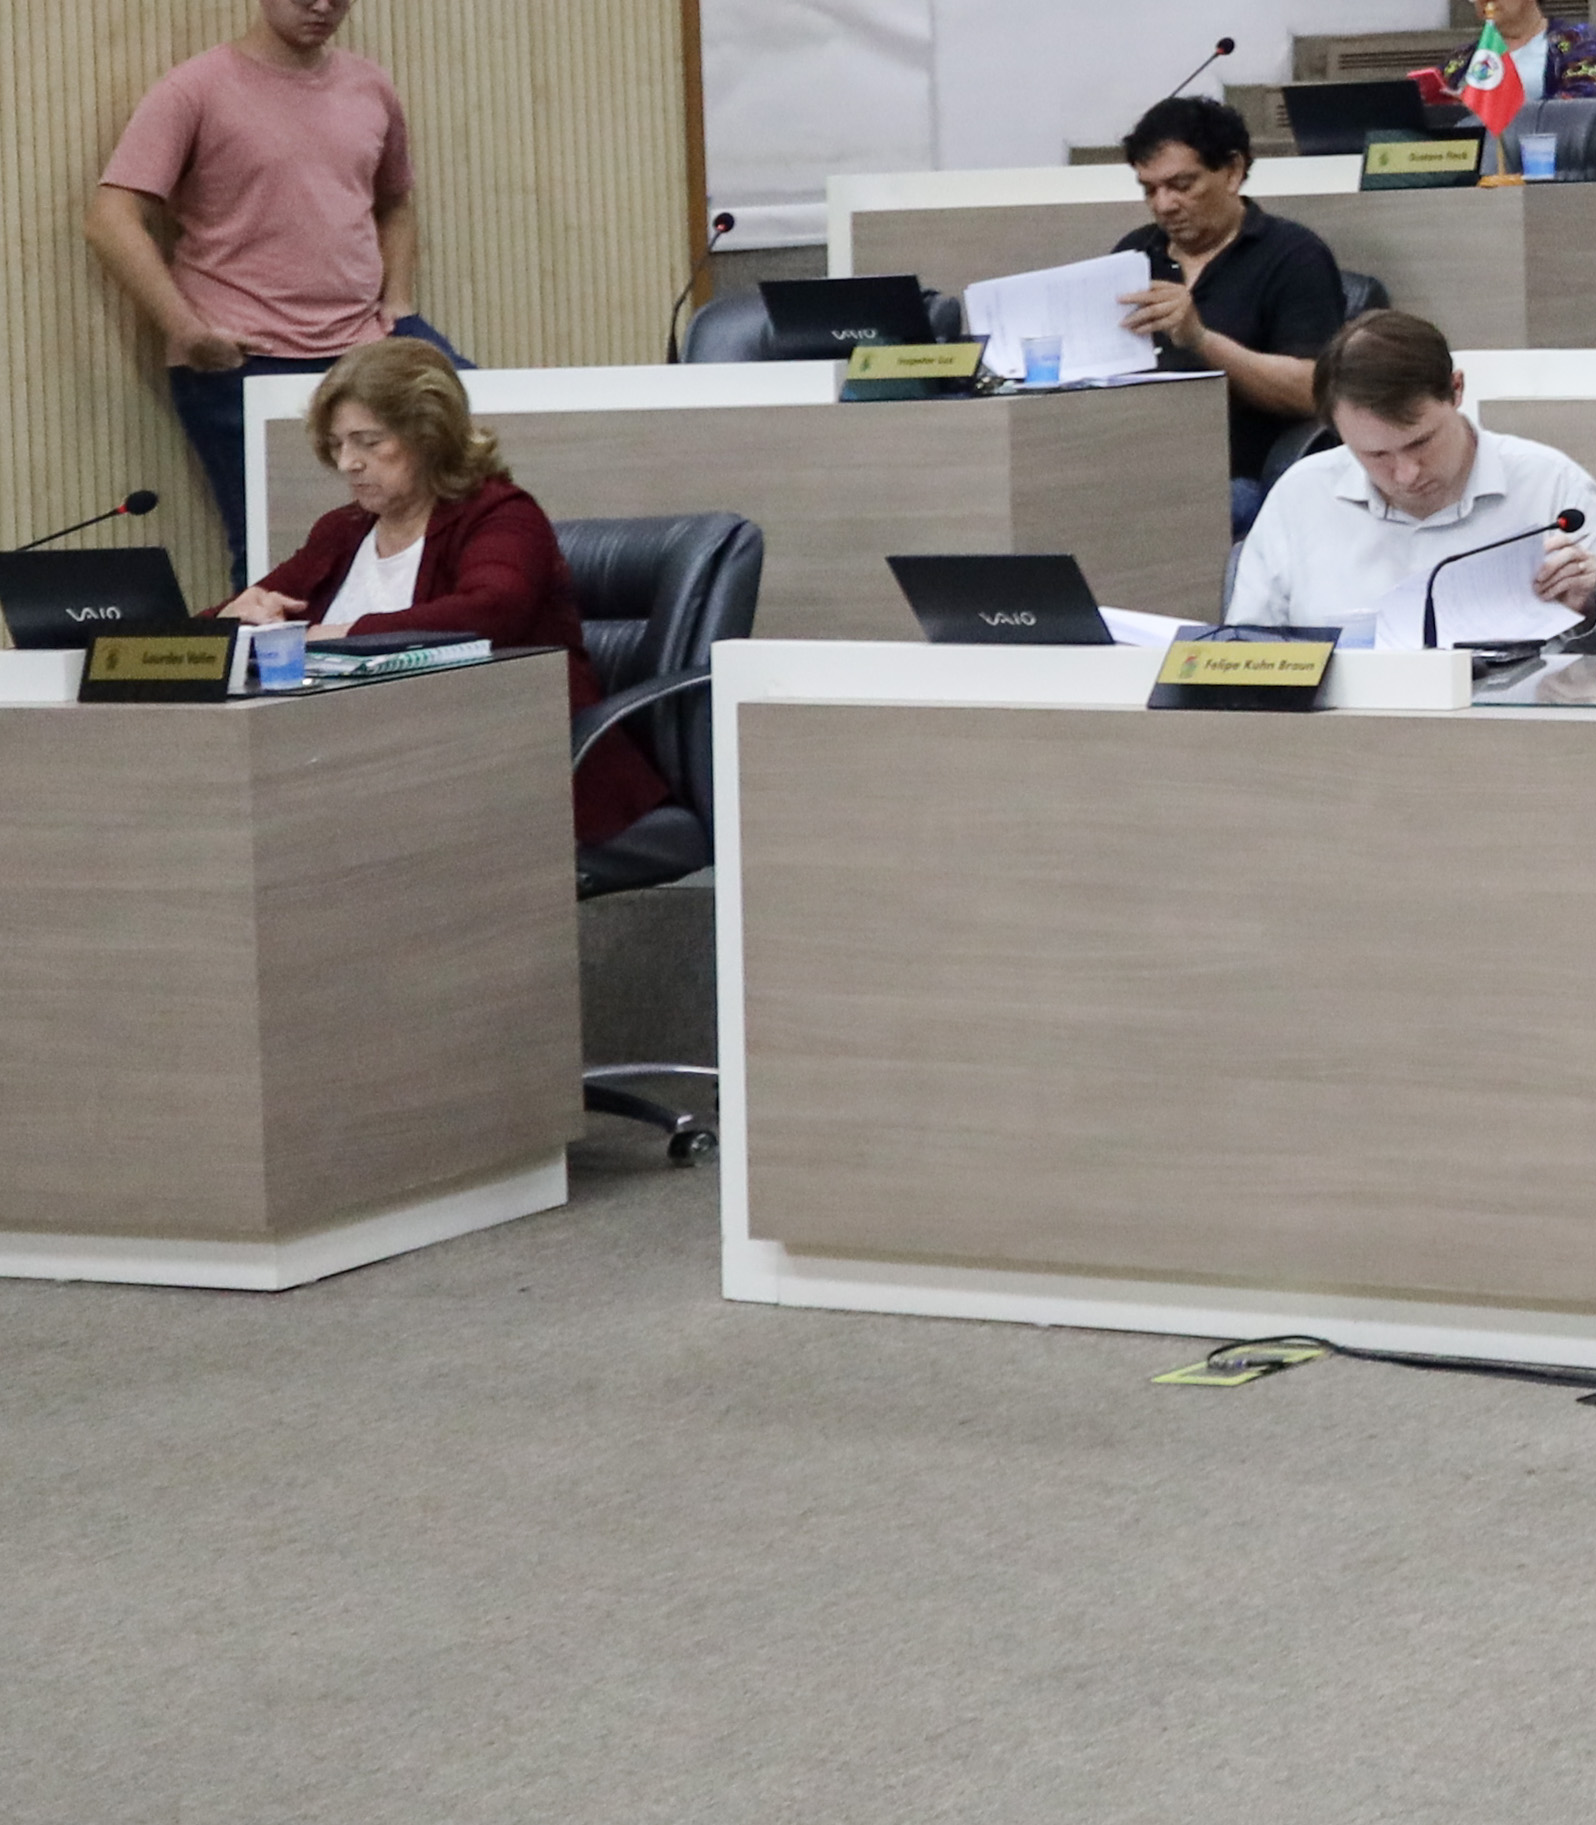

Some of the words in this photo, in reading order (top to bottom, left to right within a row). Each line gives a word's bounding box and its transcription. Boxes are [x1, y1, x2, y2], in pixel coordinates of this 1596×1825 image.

[66, 606, 122, 622] VAIO
[978, 611, 1037, 626] VAIO
[1204, 658, 1240, 672] Felipe
[1244, 659, 1275, 671] Kuhn
[1278, 660, 1315, 671] Braun
